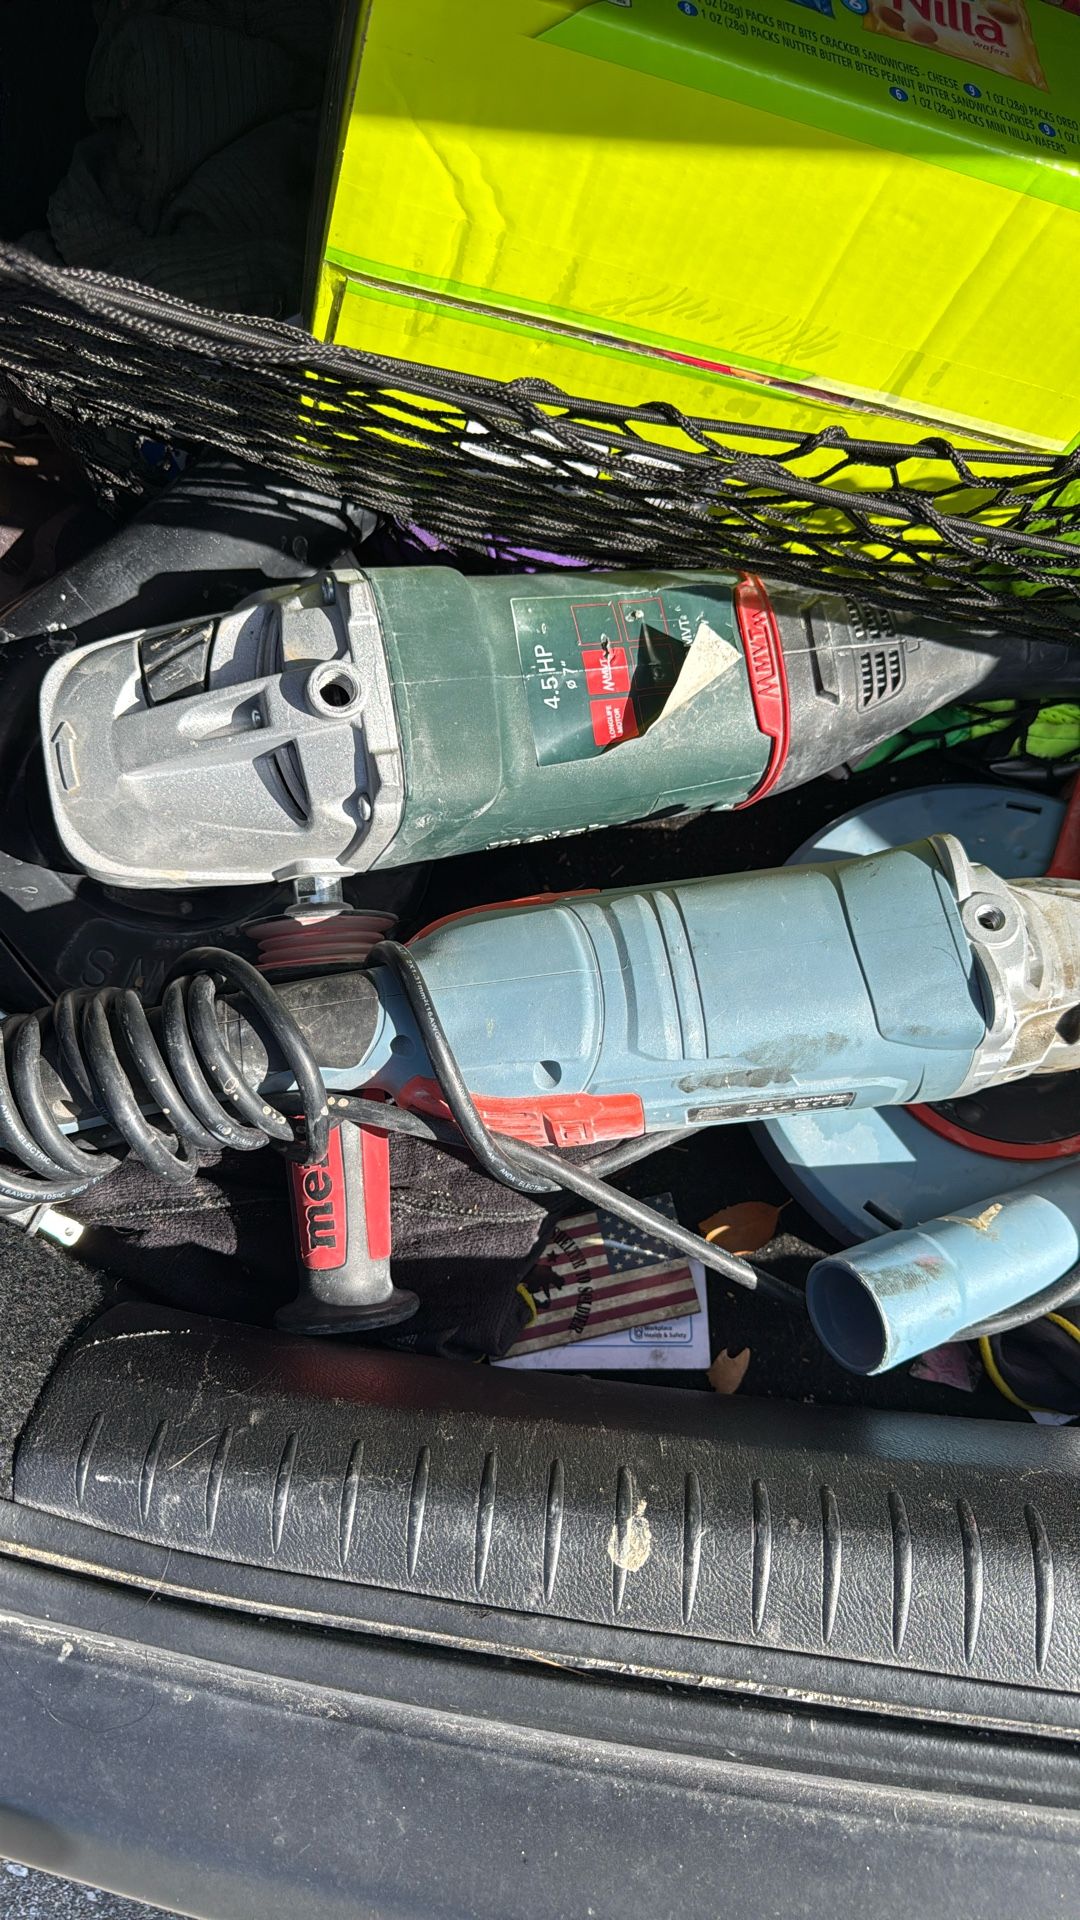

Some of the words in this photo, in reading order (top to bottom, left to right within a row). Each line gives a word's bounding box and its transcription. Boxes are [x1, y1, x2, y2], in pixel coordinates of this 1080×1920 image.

[972, 39, 1010, 59] wafers
[708, 12, 723, 26] OZ
[724, 16, 749, 36] (28g)
[750, 25, 780, 44] PACKS
[782, 35, 818, 58] NUTTER
[820, 46, 852, 68] BUTTER
[855, 60, 879, 78] BITES
[881, 70, 916, 90] PEANUT
[918, 79, 950, 99] BUTTER
[951, 91, 998, 117] SANDWICH
[1000, 109, 1036, 130] COOKIES
[745, 8, 775, 28] PACKS
[776, 19, 797, 35] RITZ
[799, 27, 818, 42] BITS
[820, 32, 861, 58] CRACKER
[862, 49, 920, 77] SANDWICHES
[927, 70, 960, 90] CHEESE
[1006, 96, 1028, 116] (28g)
[1029, 104, 1055, 122] PACKS
[1055, 114, 1079, 131] OREO
[919, 97, 934, 111] OZ
[934, 101, 957, 120] (28g)
[957, 109, 985, 128] PACKS
[986, 119, 1008, 136] MINI
[1009, 125, 1033, 143] NILLA
[1033, 133, 1068, 155] WAFERS
[534, 644, 557, 673] HP
[540, 676, 561, 710] 4.5
[605, 704, 617, 739] LONGLIFE
[614, 707, 624, 735] MOTOR
[18, 1134, 52, 1166] ELECTRIC
[302, 1152, 337, 1250] me
[576, 1269, 592, 1284] TO
[568, 1286, 593, 1334] SOLDIER
[669, 1332, 687, 1340] Safety
